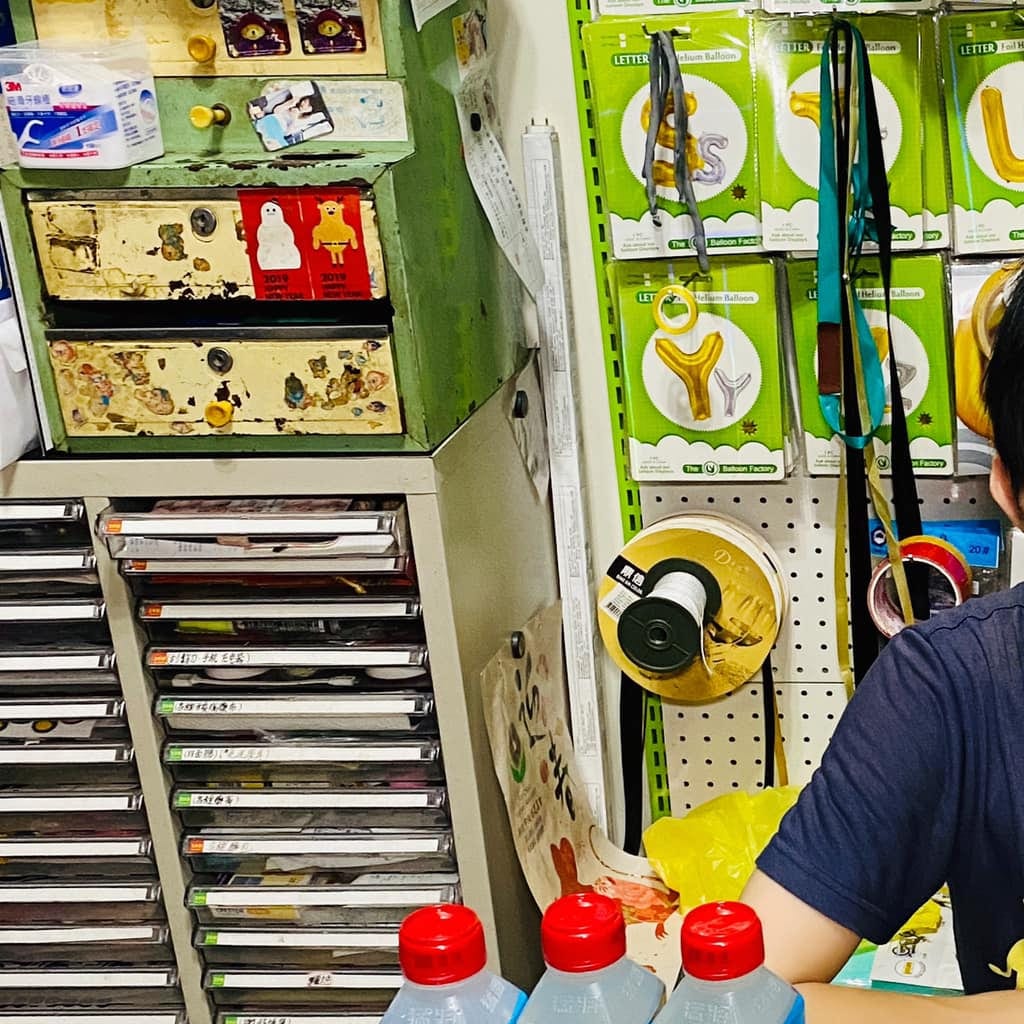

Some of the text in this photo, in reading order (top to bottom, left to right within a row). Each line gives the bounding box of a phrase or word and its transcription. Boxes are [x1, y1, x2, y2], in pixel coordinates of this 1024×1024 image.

[961, 43, 995, 55] LETTER
[705, 52, 737, 62] Balloon
[5, 82, 22, 92] 3M
[671, 240, 686, 249] The
[711, 237, 737, 247] Balloon
[738, 236, 762, 246] Fact
[264, 274, 288, 282] 2019
[321, 272, 346, 280] 2019
[724, 294, 754, 302] Balloon
[687, 464, 775, 474] The Balloon Factory
[919, 460, 944, 469] Factory
